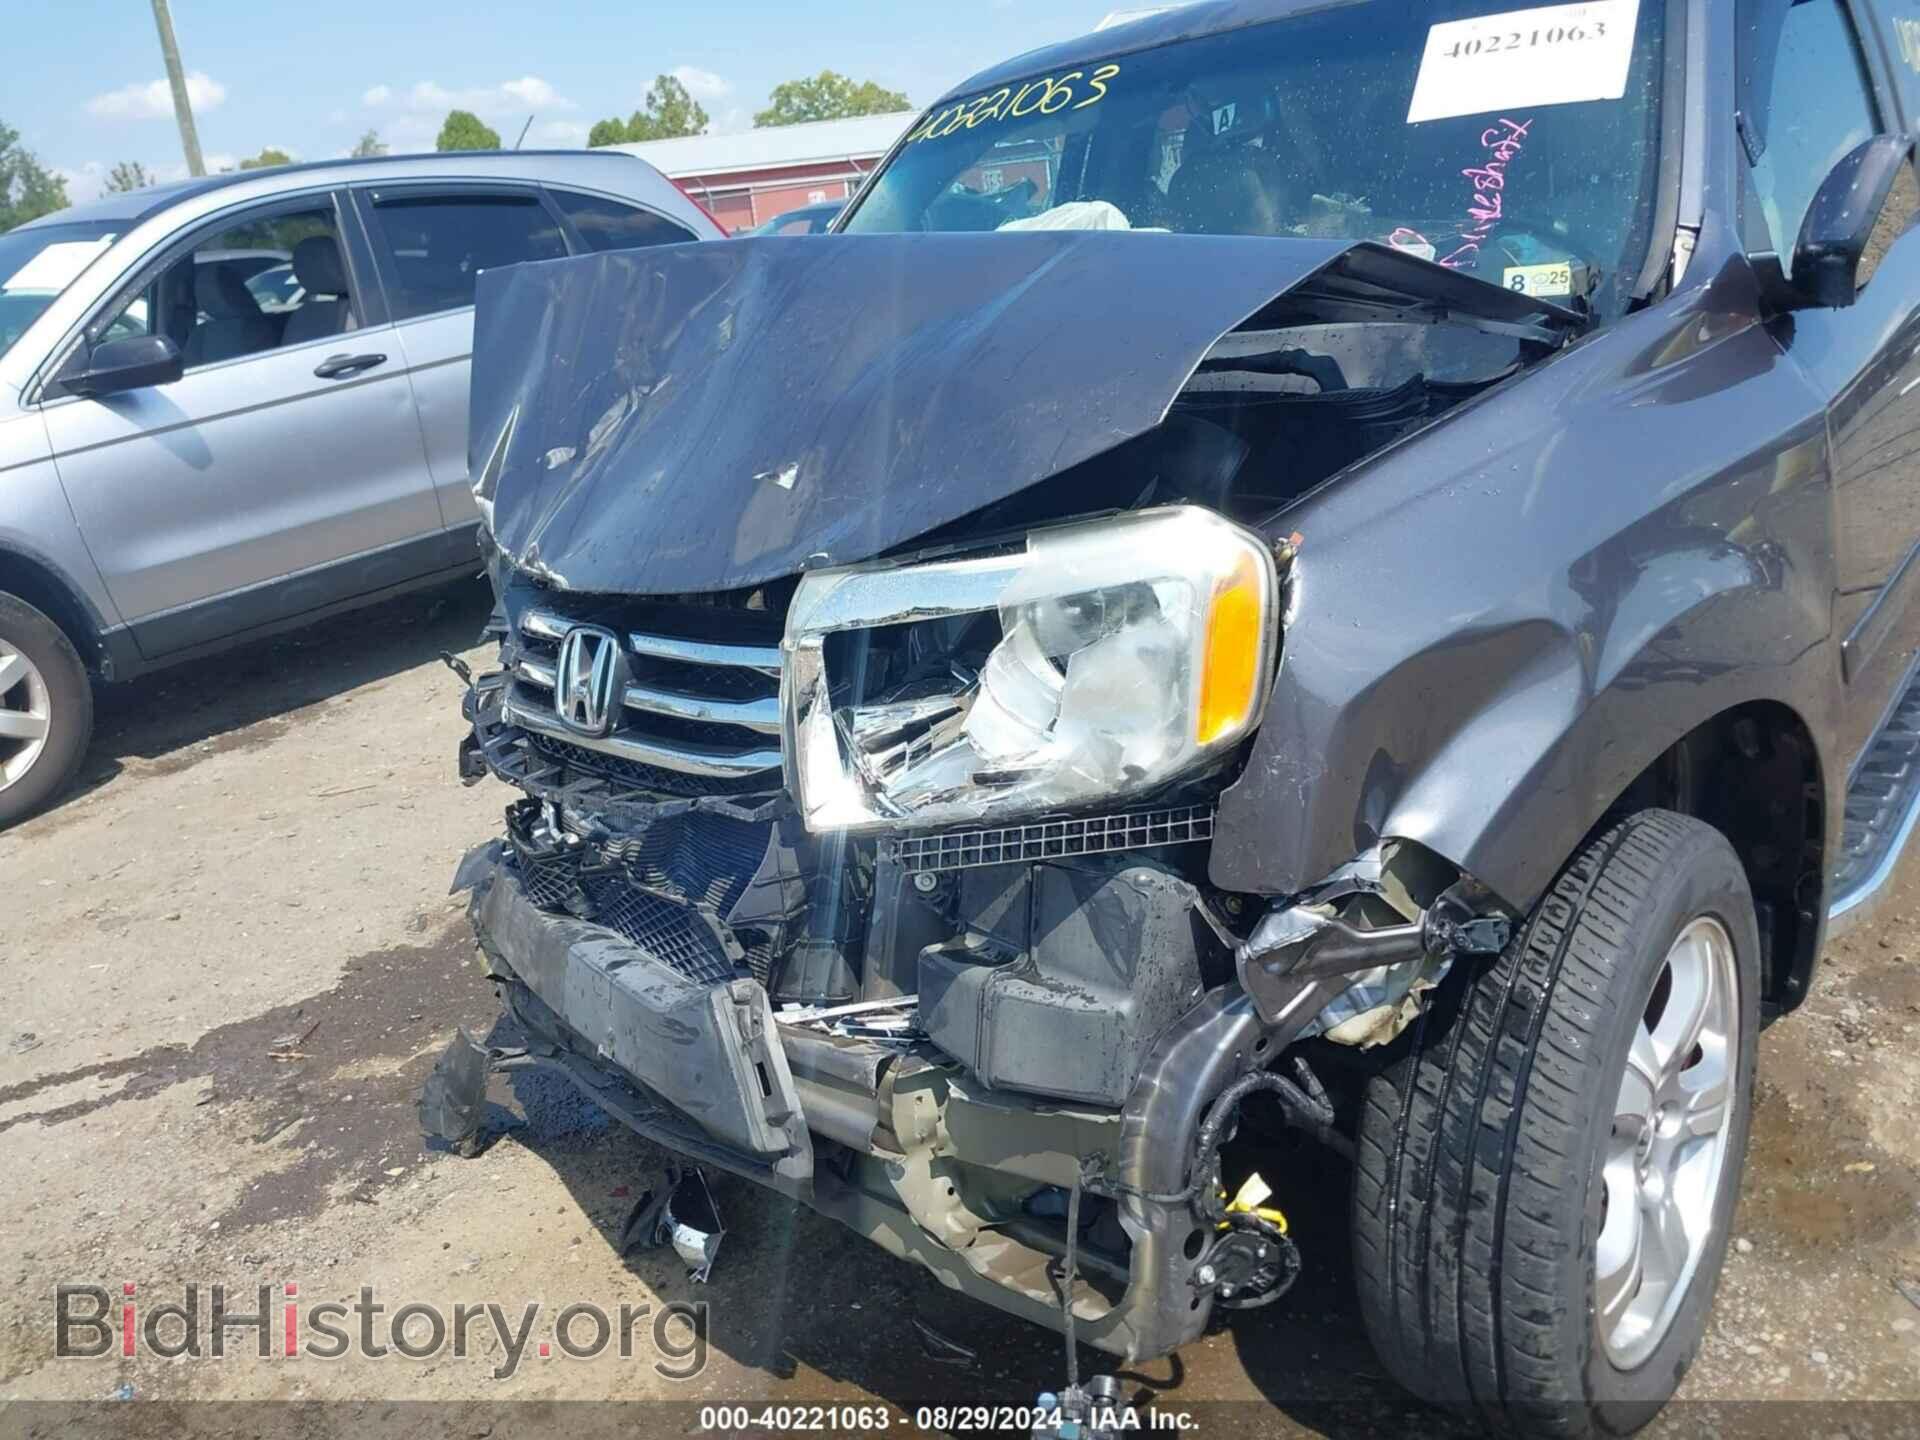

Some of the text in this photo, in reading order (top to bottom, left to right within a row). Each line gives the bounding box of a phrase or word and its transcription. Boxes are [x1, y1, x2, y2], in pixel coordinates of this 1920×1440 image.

[1444, 22, 1605, 58] 40221063
[1511, 271, 1569, 292] 8 25
